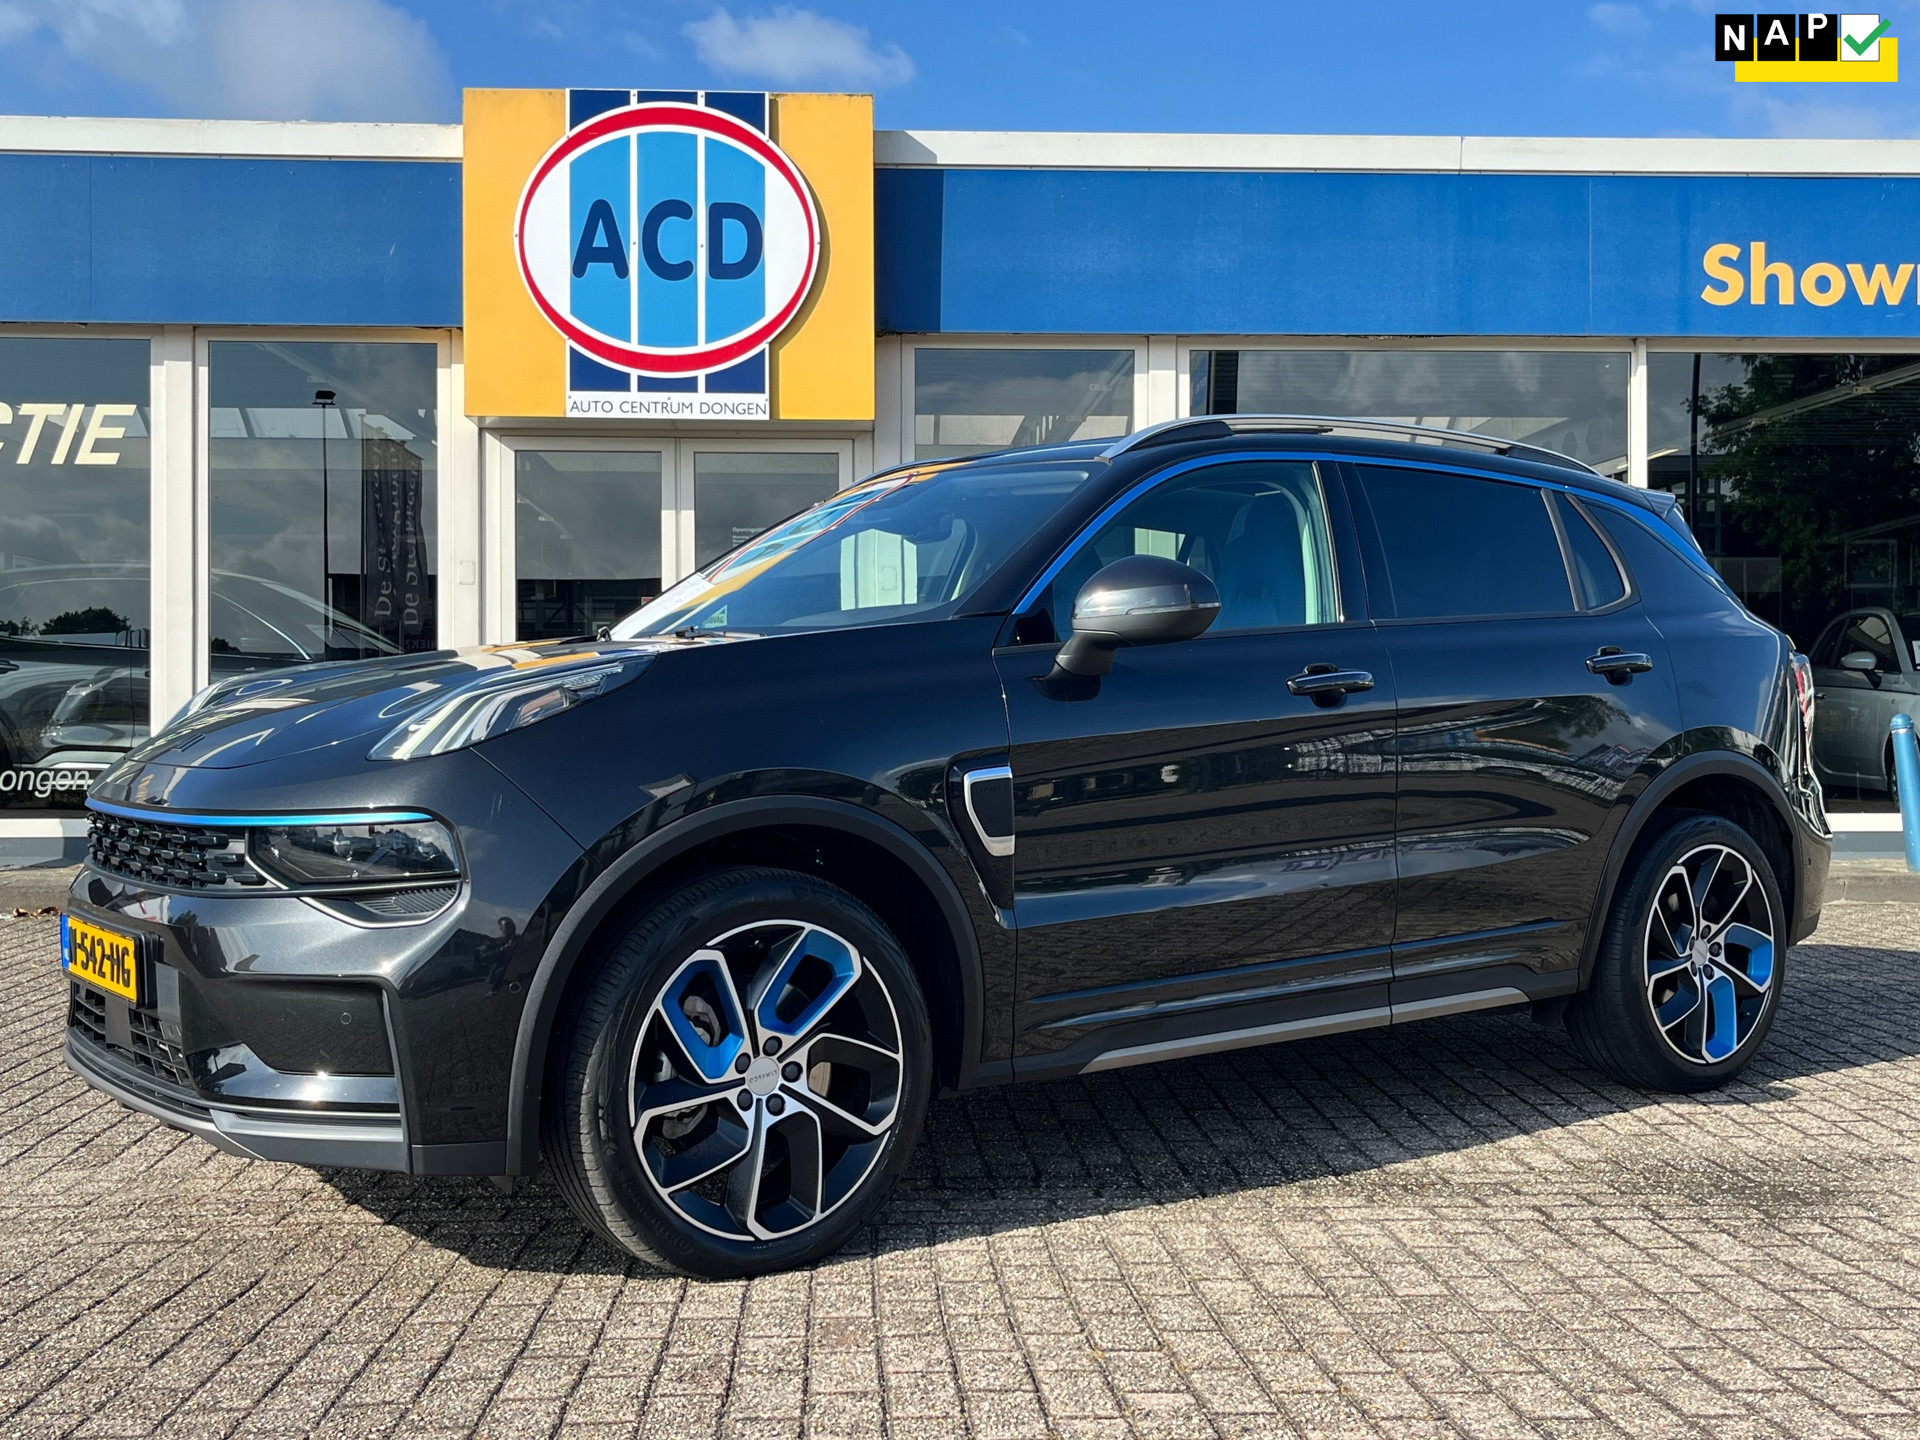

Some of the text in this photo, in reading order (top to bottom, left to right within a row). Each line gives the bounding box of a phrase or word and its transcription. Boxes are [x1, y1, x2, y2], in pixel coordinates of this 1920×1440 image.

[572, 198, 764, 281] ACD
[1700, 241, 1920, 307] Show
[0, 402, 137, 465] TIE
[570, 400, 767, 415] AUTO CENTRUM DONGEN
[0, 770, 90, 798] ongen
